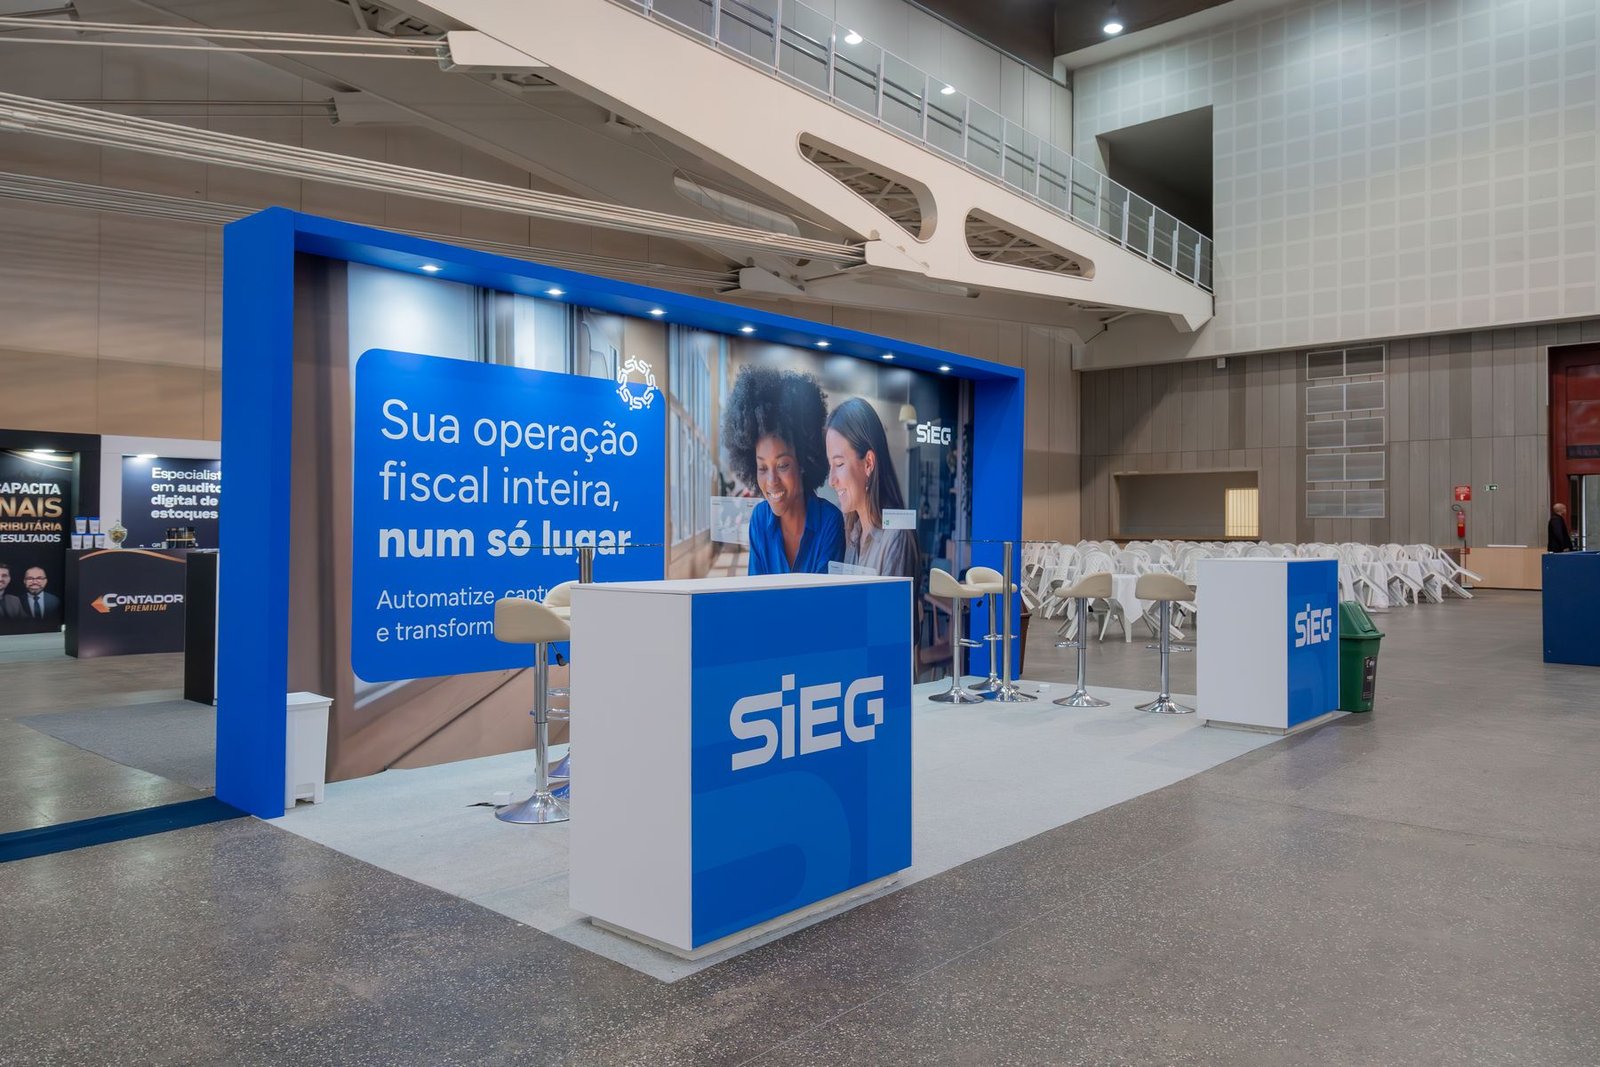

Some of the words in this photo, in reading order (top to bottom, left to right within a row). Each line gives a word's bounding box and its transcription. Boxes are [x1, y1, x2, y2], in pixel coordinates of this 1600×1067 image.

[381, 398, 460, 445] Sua
[473, 419, 639, 463] operação
[0, 482, 61, 495] APACITA
[151, 483, 175, 492] em
[379, 460, 489, 504] fiscal
[502, 466, 620, 513] inteira,
[151, 494, 198, 508] digital
[200, 495, 219, 506] de
[151, 508, 219, 521] estoques
[0, 533, 62, 543] ESULTADOS
[379, 526, 475, 559] num
[487, 519, 532, 558] só
[542, 520, 633, 564] lugar
[102, 593, 184, 608] CONTADOR
[124, 604, 167, 612] PREMIUM
[376, 624, 390, 643] e
